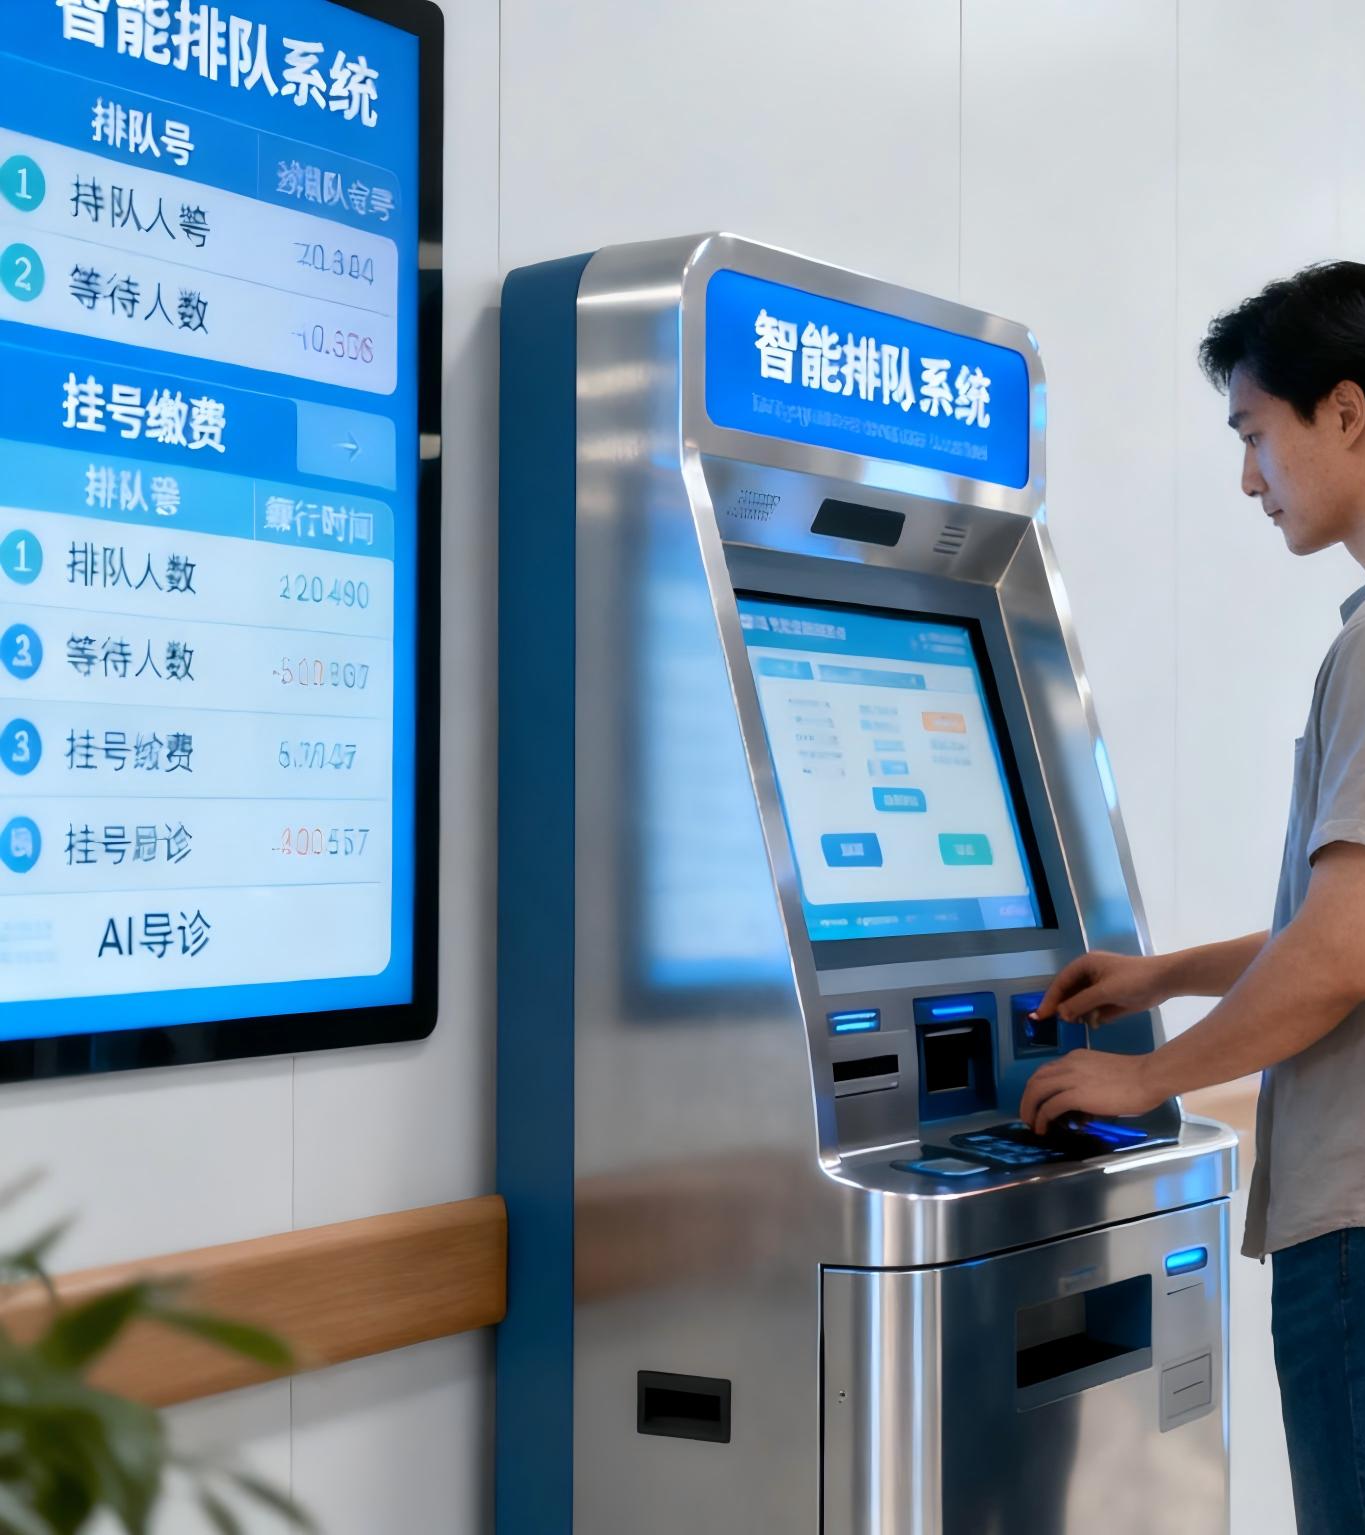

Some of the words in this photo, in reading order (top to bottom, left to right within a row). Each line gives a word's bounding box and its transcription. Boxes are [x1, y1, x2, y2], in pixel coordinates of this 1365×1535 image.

[57, 0, 380, 127] 智能排队系统
[92, 97, 195, 166] 排队号
[15, 168, 33, 200] 1
[15, 256, 32, 291] 2
[69, 264, 208, 334] 等待人数
[754, 309, 991, 429] 智能排队系统
[62, 372, 226, 453] 挂号缴费
[13, 540, 32, 572] 1
[66, 541, 197, 594] 排队人数
[66, 633, 195, 681] 等待人数
[98, 909, 211, 958] AI导诊
